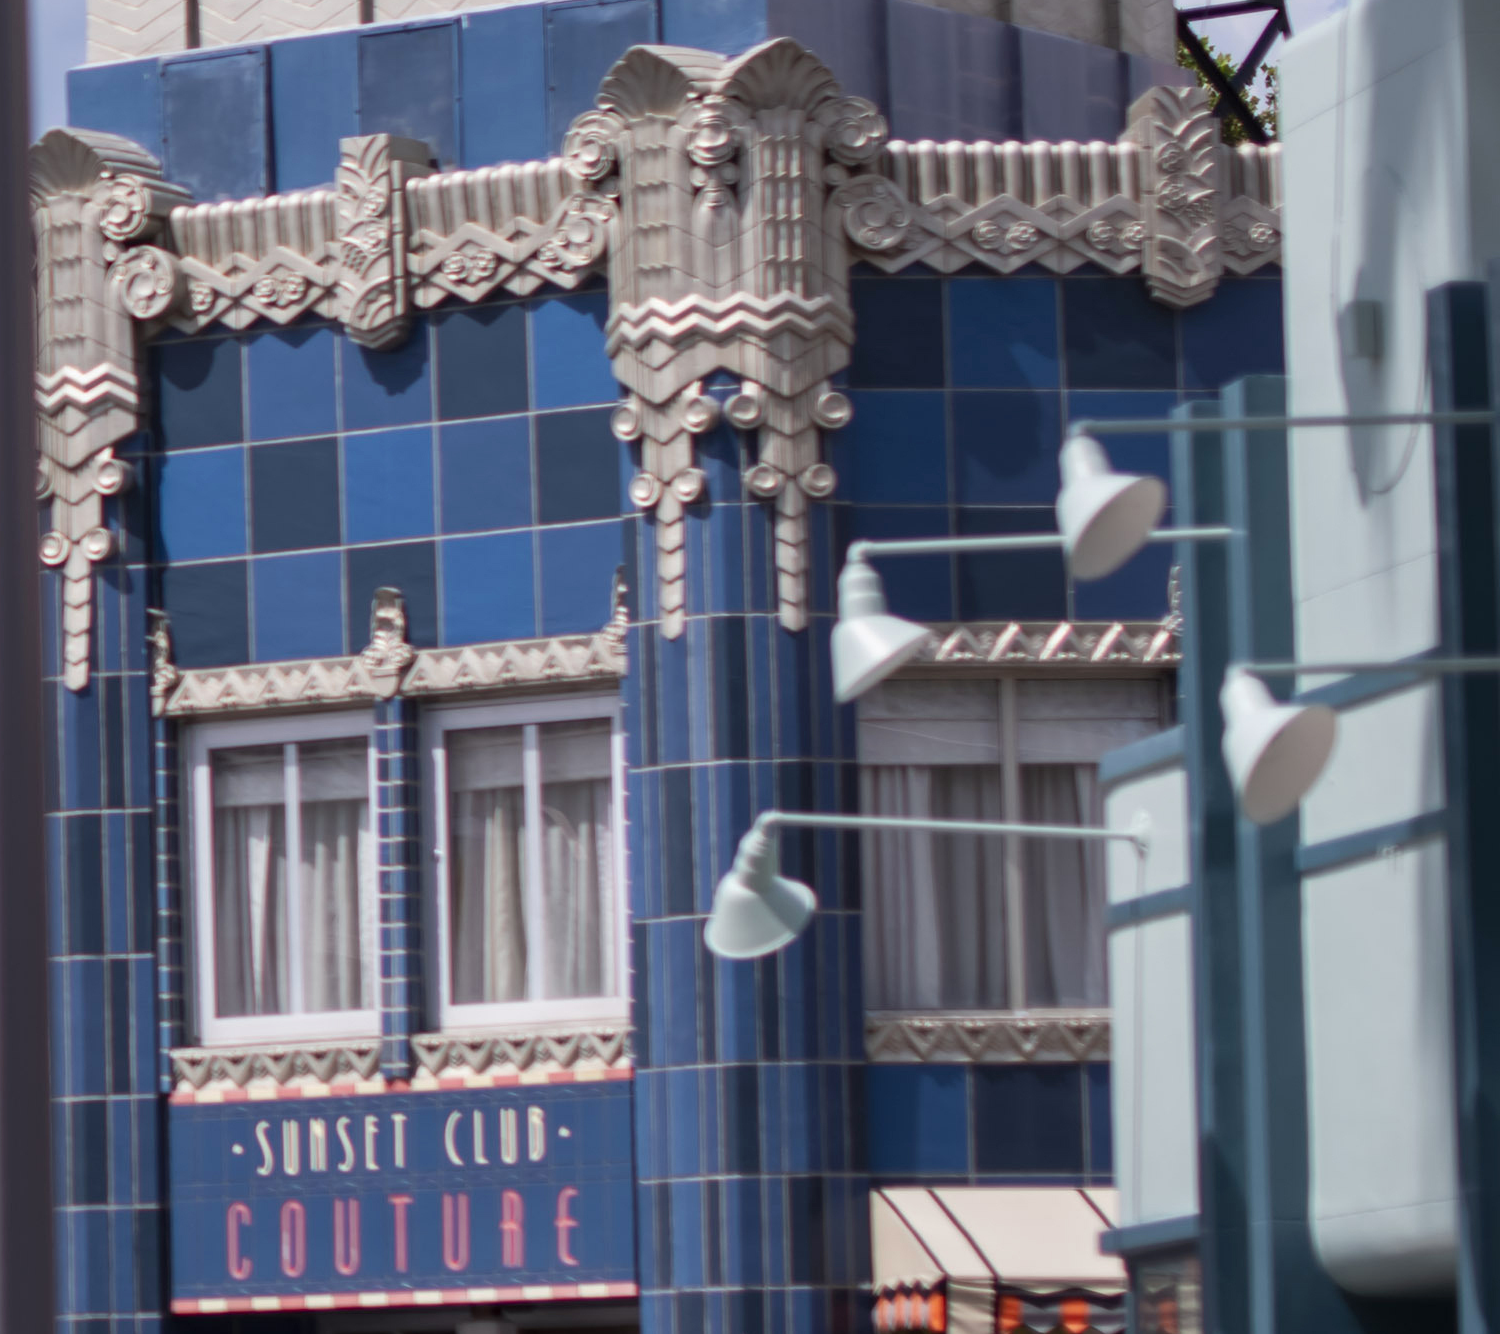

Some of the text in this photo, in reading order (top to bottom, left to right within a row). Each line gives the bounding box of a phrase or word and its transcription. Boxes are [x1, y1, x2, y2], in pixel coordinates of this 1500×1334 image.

[255, 1105, 546, 1176] SUNSET CLUB
[226, 1185, 580, 1281] COUTURE
